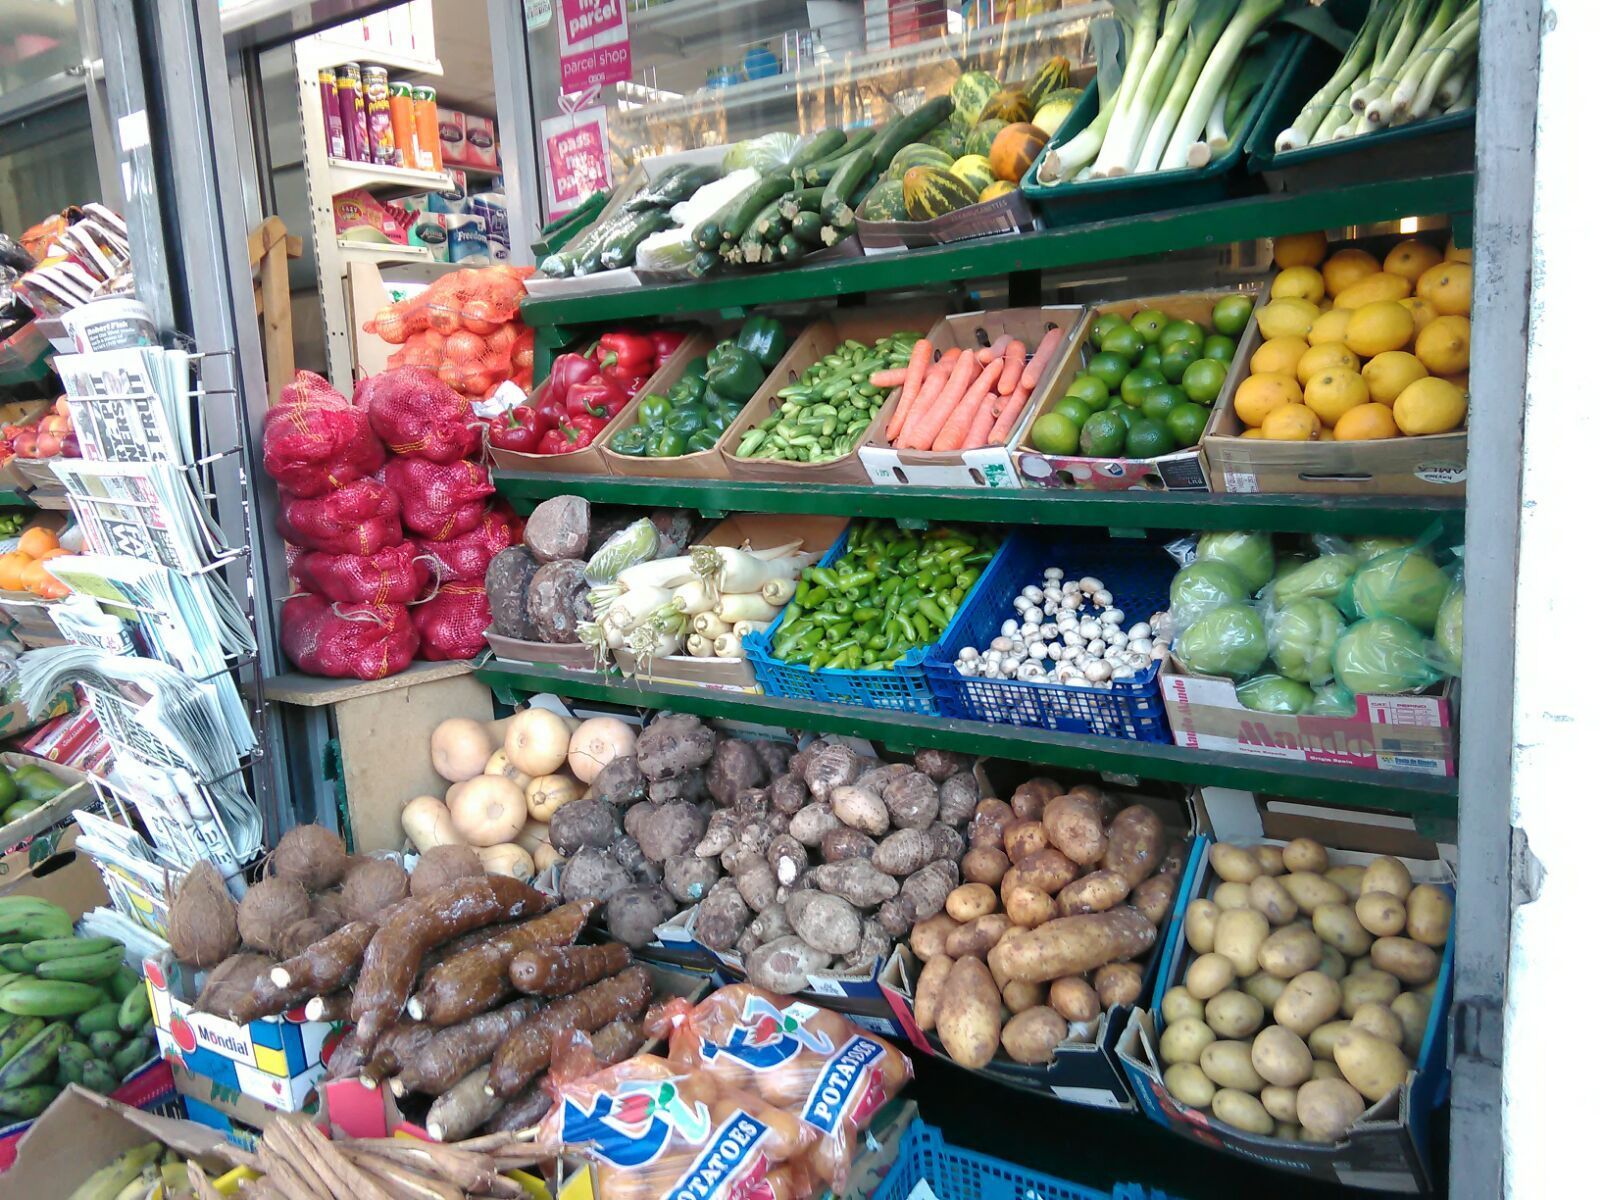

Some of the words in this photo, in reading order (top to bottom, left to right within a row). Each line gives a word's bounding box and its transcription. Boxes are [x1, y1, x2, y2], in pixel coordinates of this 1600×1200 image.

[569, 0, 618, 38] parcel
[564, 52, 597, 78] parcel
[600, 47, 627, 68] shop
[558, 133, 591, 159] pass
[566, 151, 588, 174] my
[458, 231, 488, 242] Freedom
[1238, 719, 1375, 758] Mando
[1310, 755, 1331, 763] Origin
[197, 1024, 250, 1057] Mondial
[814, 1037, 877, 1123] POTATOES
[676, 1119, 758, 1200] OTATOES
